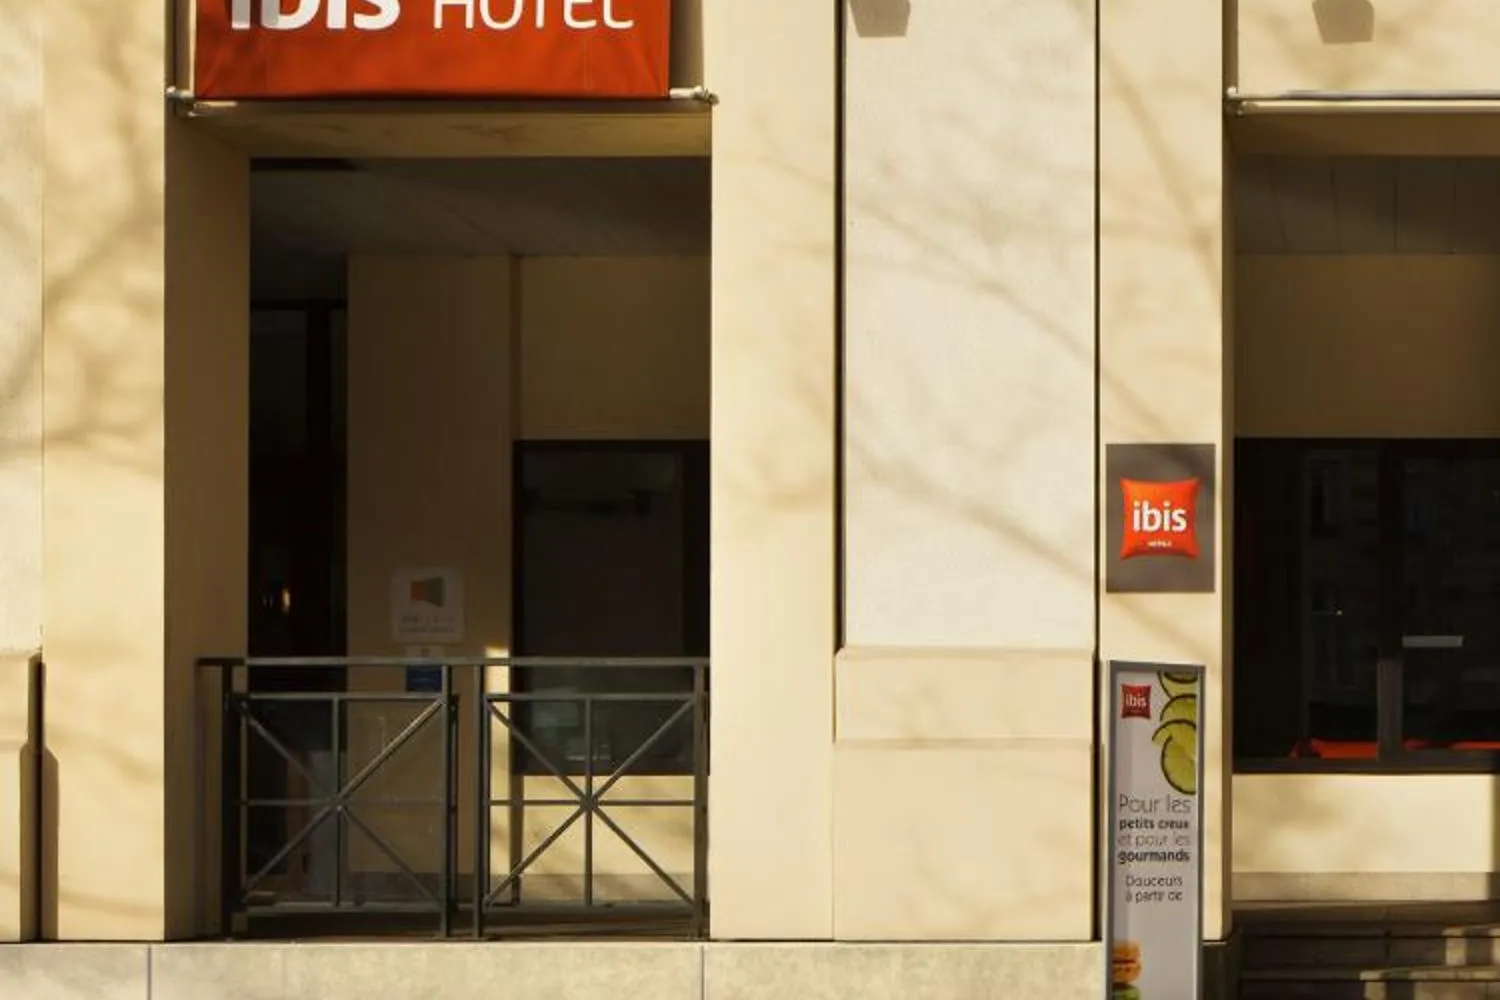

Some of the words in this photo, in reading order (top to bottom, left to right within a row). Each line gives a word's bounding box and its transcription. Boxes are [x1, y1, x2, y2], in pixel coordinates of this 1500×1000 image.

[1132, 500, 1188, 533] ibis
[1119, 793, 1161, 813] Pour
[1166, 793, 1191, 813] les
[1119, 817, 1155, 831] petits
[1118, 849, 1190, 865] gourmands
